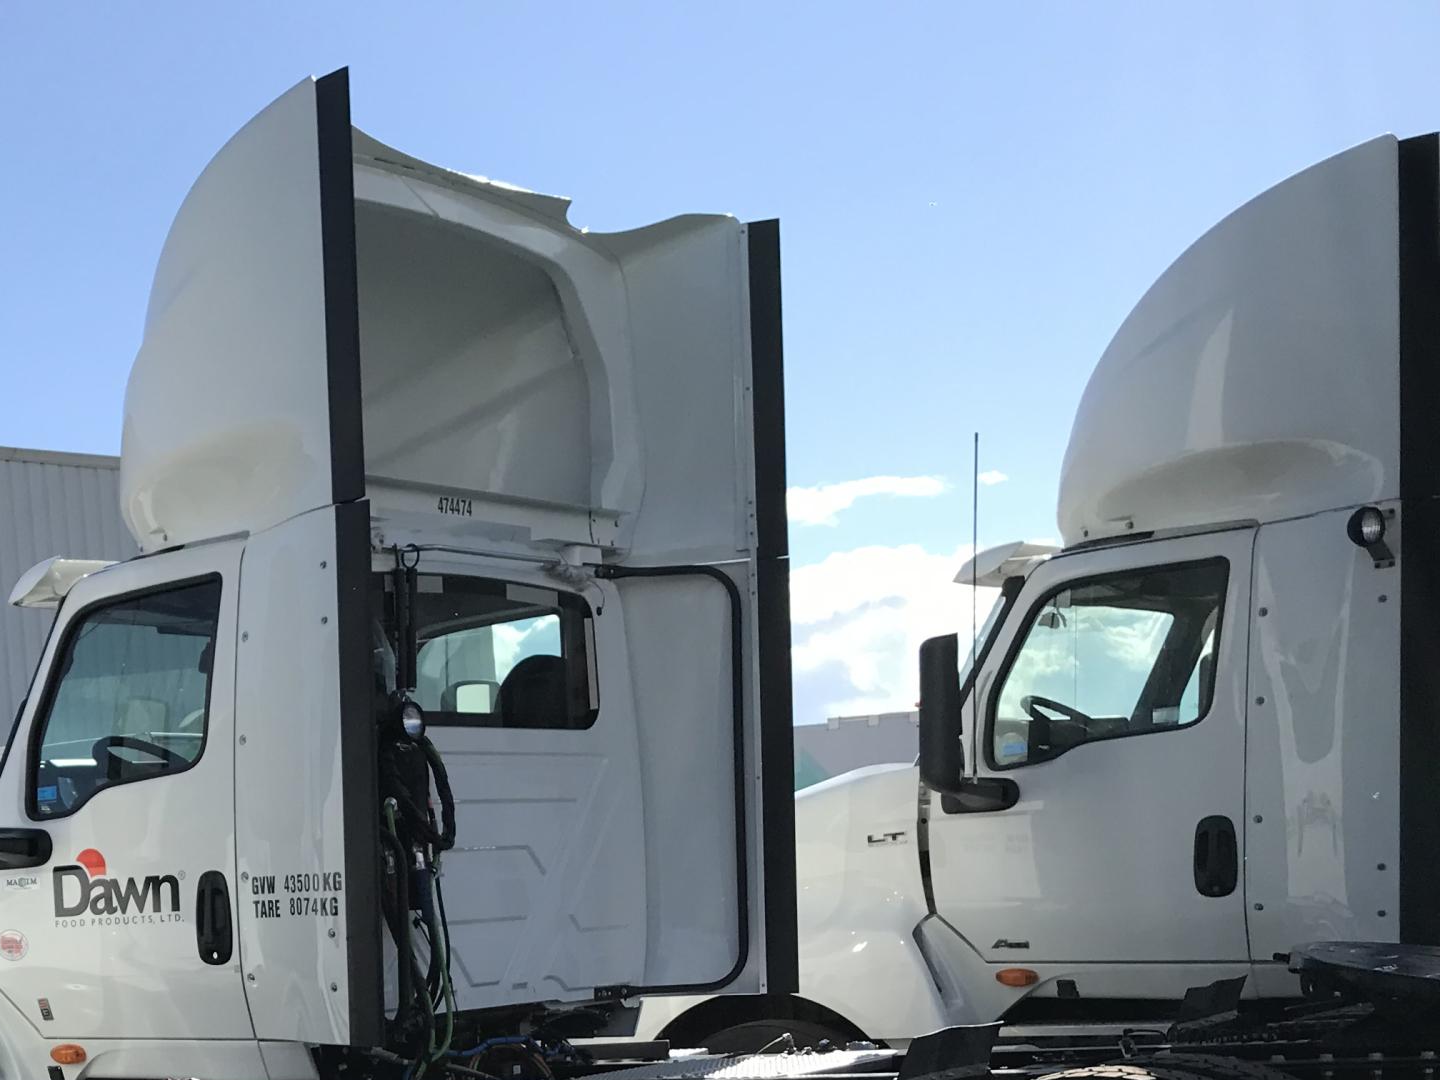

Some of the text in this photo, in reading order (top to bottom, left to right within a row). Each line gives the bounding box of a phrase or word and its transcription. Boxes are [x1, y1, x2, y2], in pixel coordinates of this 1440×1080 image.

[437, 496, 472, 517] 474474
[53, 865, 180, 918] Dawn
[252, 876, 276, 895] GVW
[253, 899, 281, 918] TARE
[55, 919, 86, 928] FOOD
[160, 914, 185, 923] LTD.
